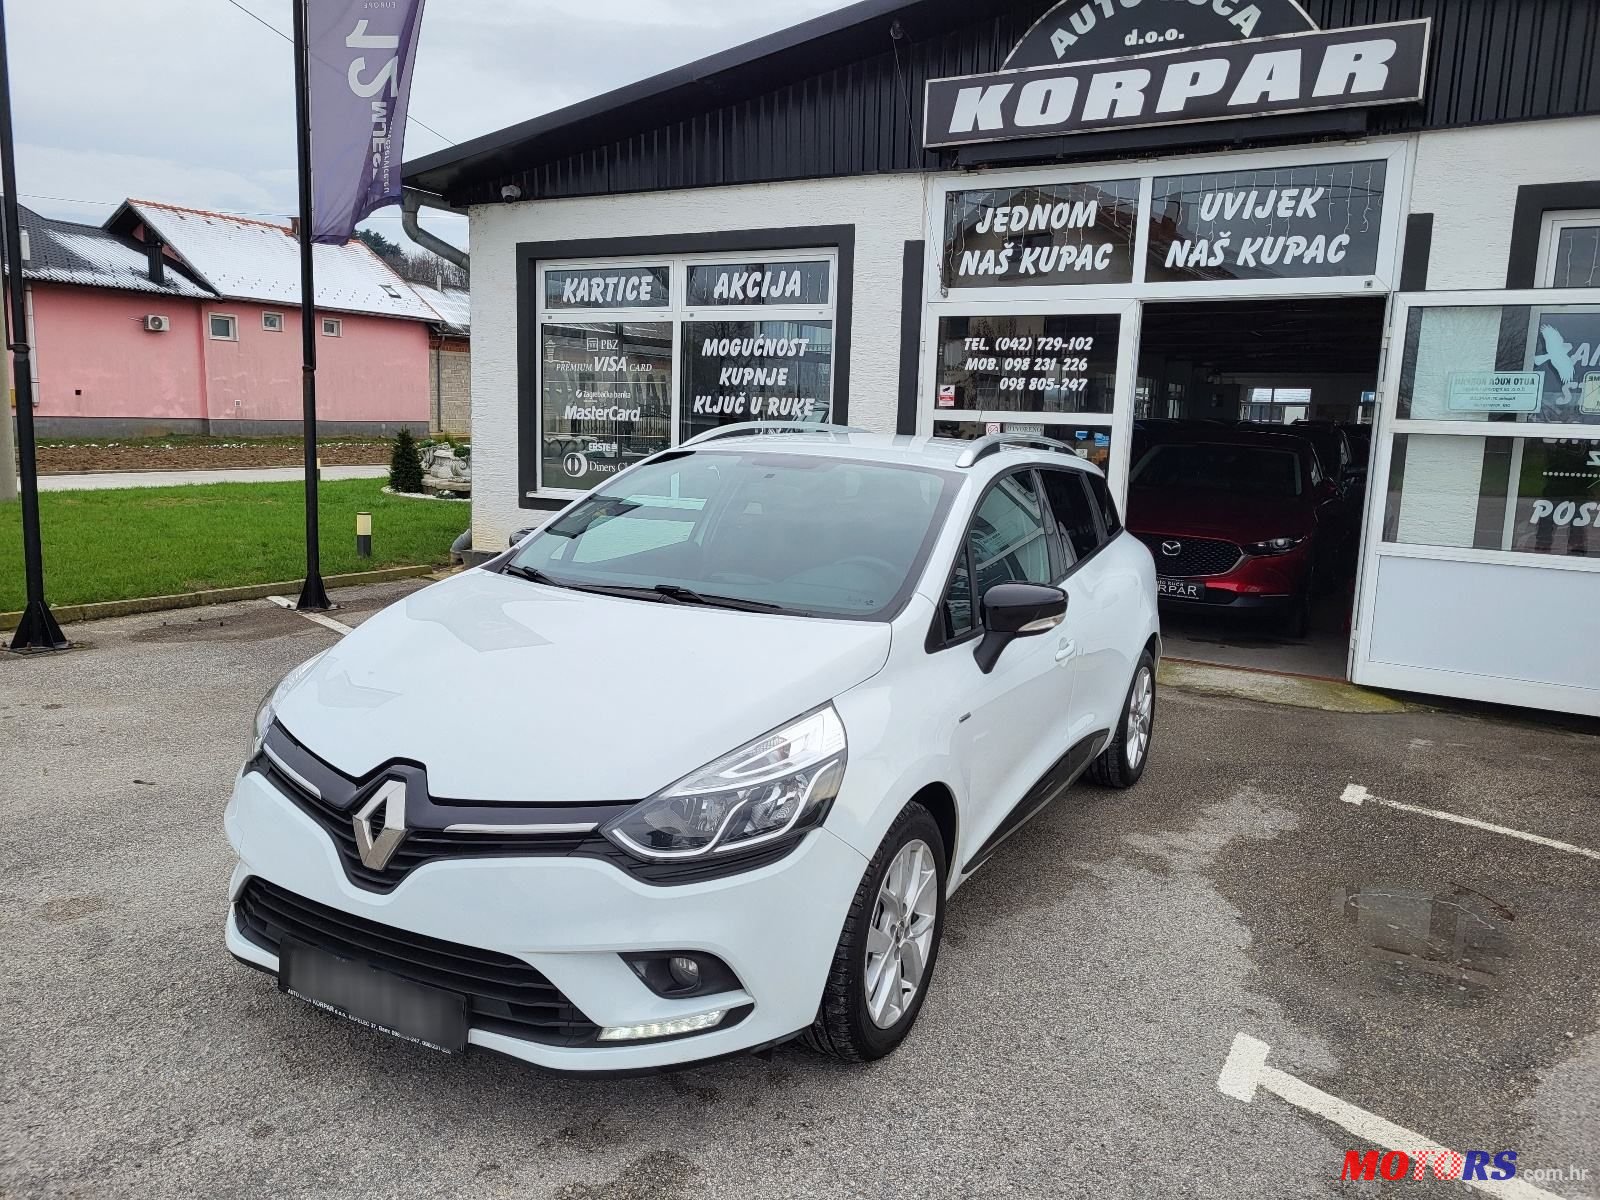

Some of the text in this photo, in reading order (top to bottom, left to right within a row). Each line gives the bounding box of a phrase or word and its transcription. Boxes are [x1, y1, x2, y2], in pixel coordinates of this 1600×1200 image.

[1124, 28, 1185, 46] d.o.o.
[948, 38, 1398, 134] KORPAR
[1200, 187, 1325, 222] UVIJEK
[975, 200, 1098, 234] JEDNOM
[958, 242, 1113, 276] NAŠ KUPAC
[1164, 231, 1350, 268] NAŠ KUPAC
[562, 275, 653, 304] KARTICE
[713, 270, 801, 299] AKCIJA
[601, 339, 619, 350] PBZ
[701, 334, 810, 357] MOGUĆNOST
[964, 336, 1094, 351] TEL. (042) 729-102
[556, 355, 653, 372] PREMIUM VISA CARD
[964, 357, 1088, 371] MOB. 098 231 226
[719, 367, 789, 387] KUPNJE
[1000, 377, 1088, 392] 098 805-247
[564, 405, 641, 422] MasterCard
[693, 391, 816, 417] KLJUČ U RUKE
[588, 443, 611, 452] ERSTE
[589, 461, 616, 472] Diners
